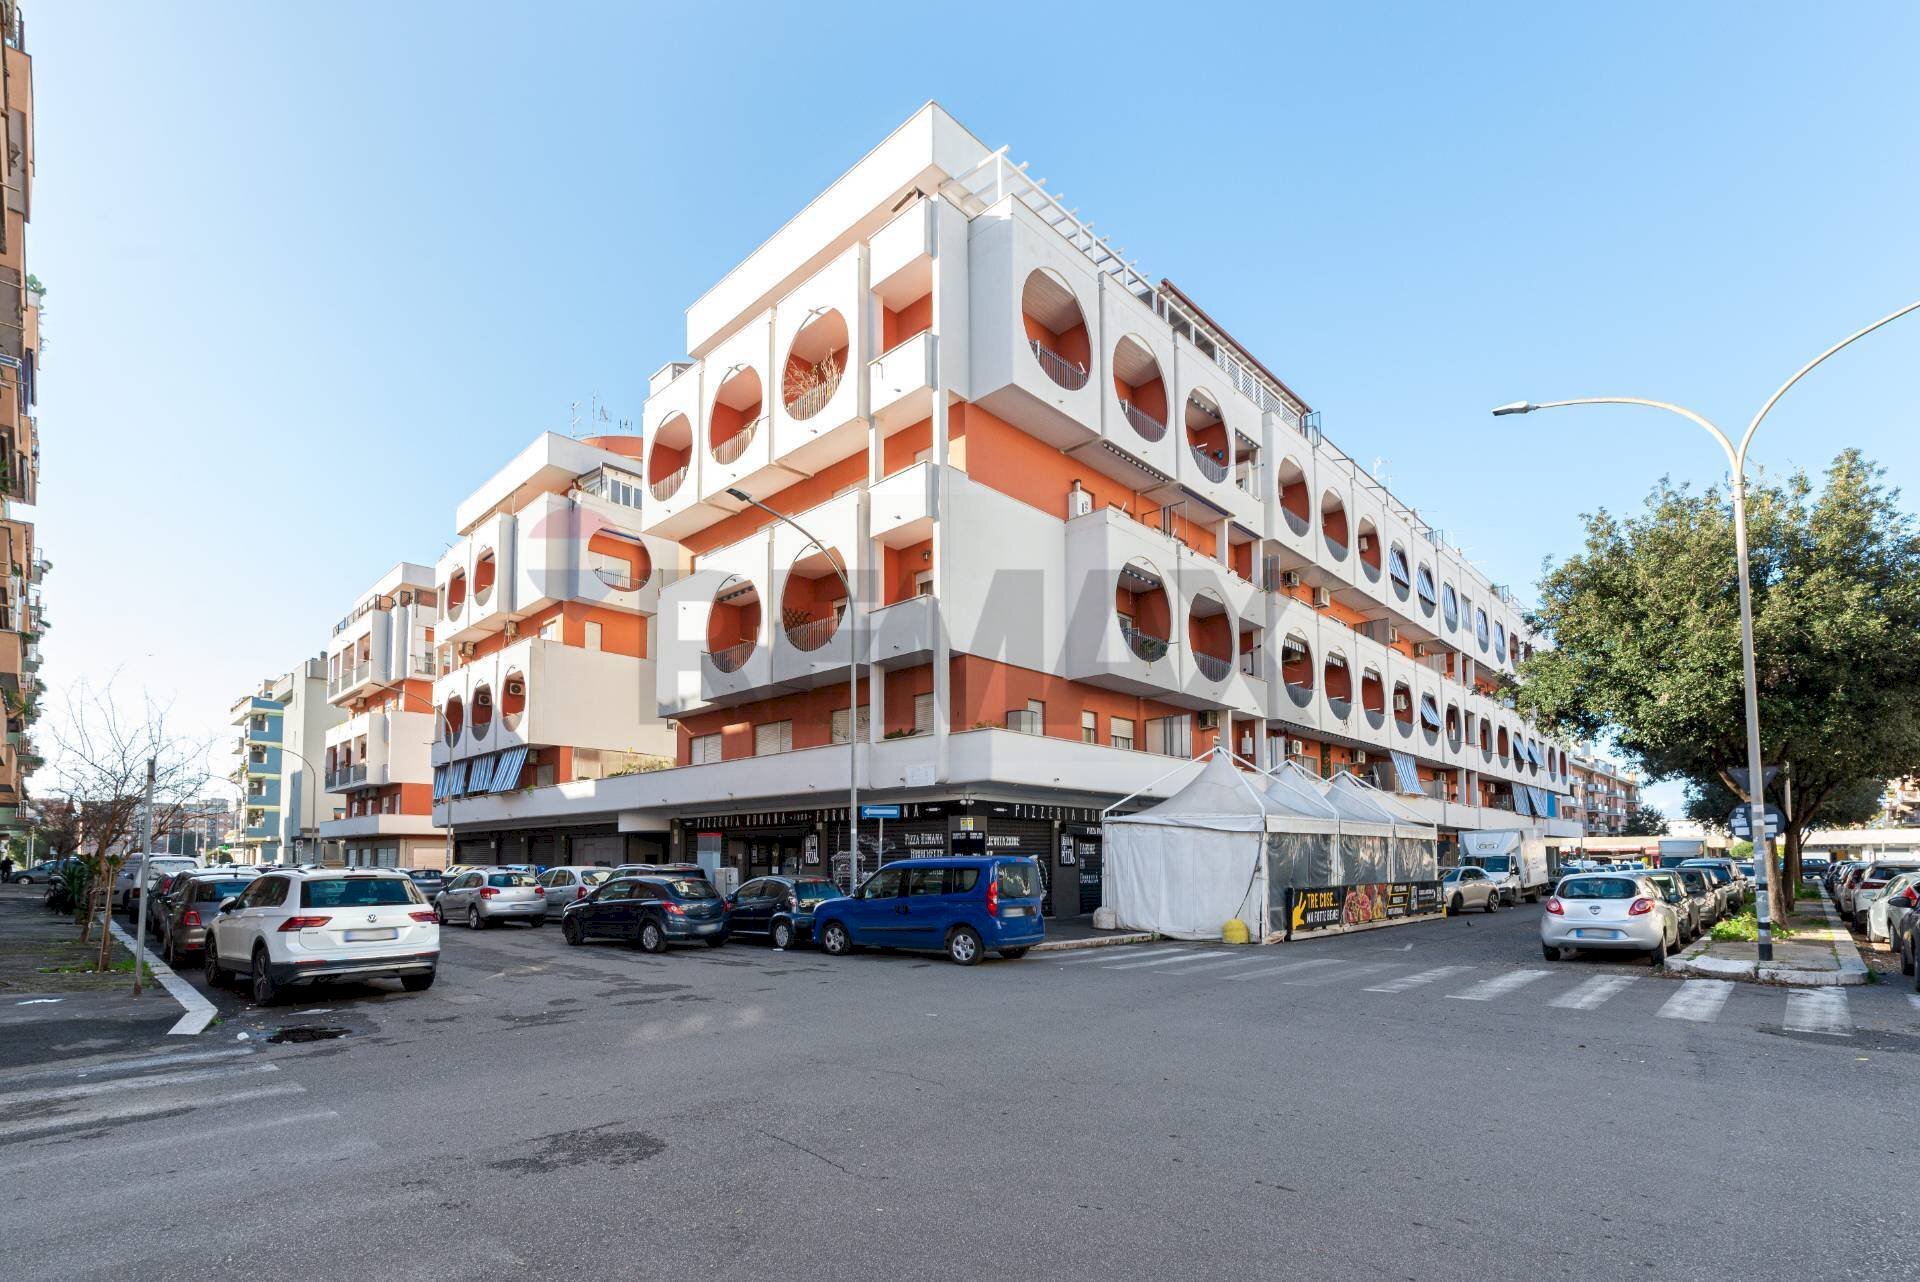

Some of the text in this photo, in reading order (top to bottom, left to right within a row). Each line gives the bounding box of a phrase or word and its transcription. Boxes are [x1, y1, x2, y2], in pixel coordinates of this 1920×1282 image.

[697, 816, 740, 829] PIZZERIA
[746, 812, 786, 826] ROMANA
[1015, 805, 1076, 821] PIZZERIA
[904, 833, 920, 845] PIZZA
[1306, 892, 1319, 909] TRE
[1306, 911, 1314, 924] MA
